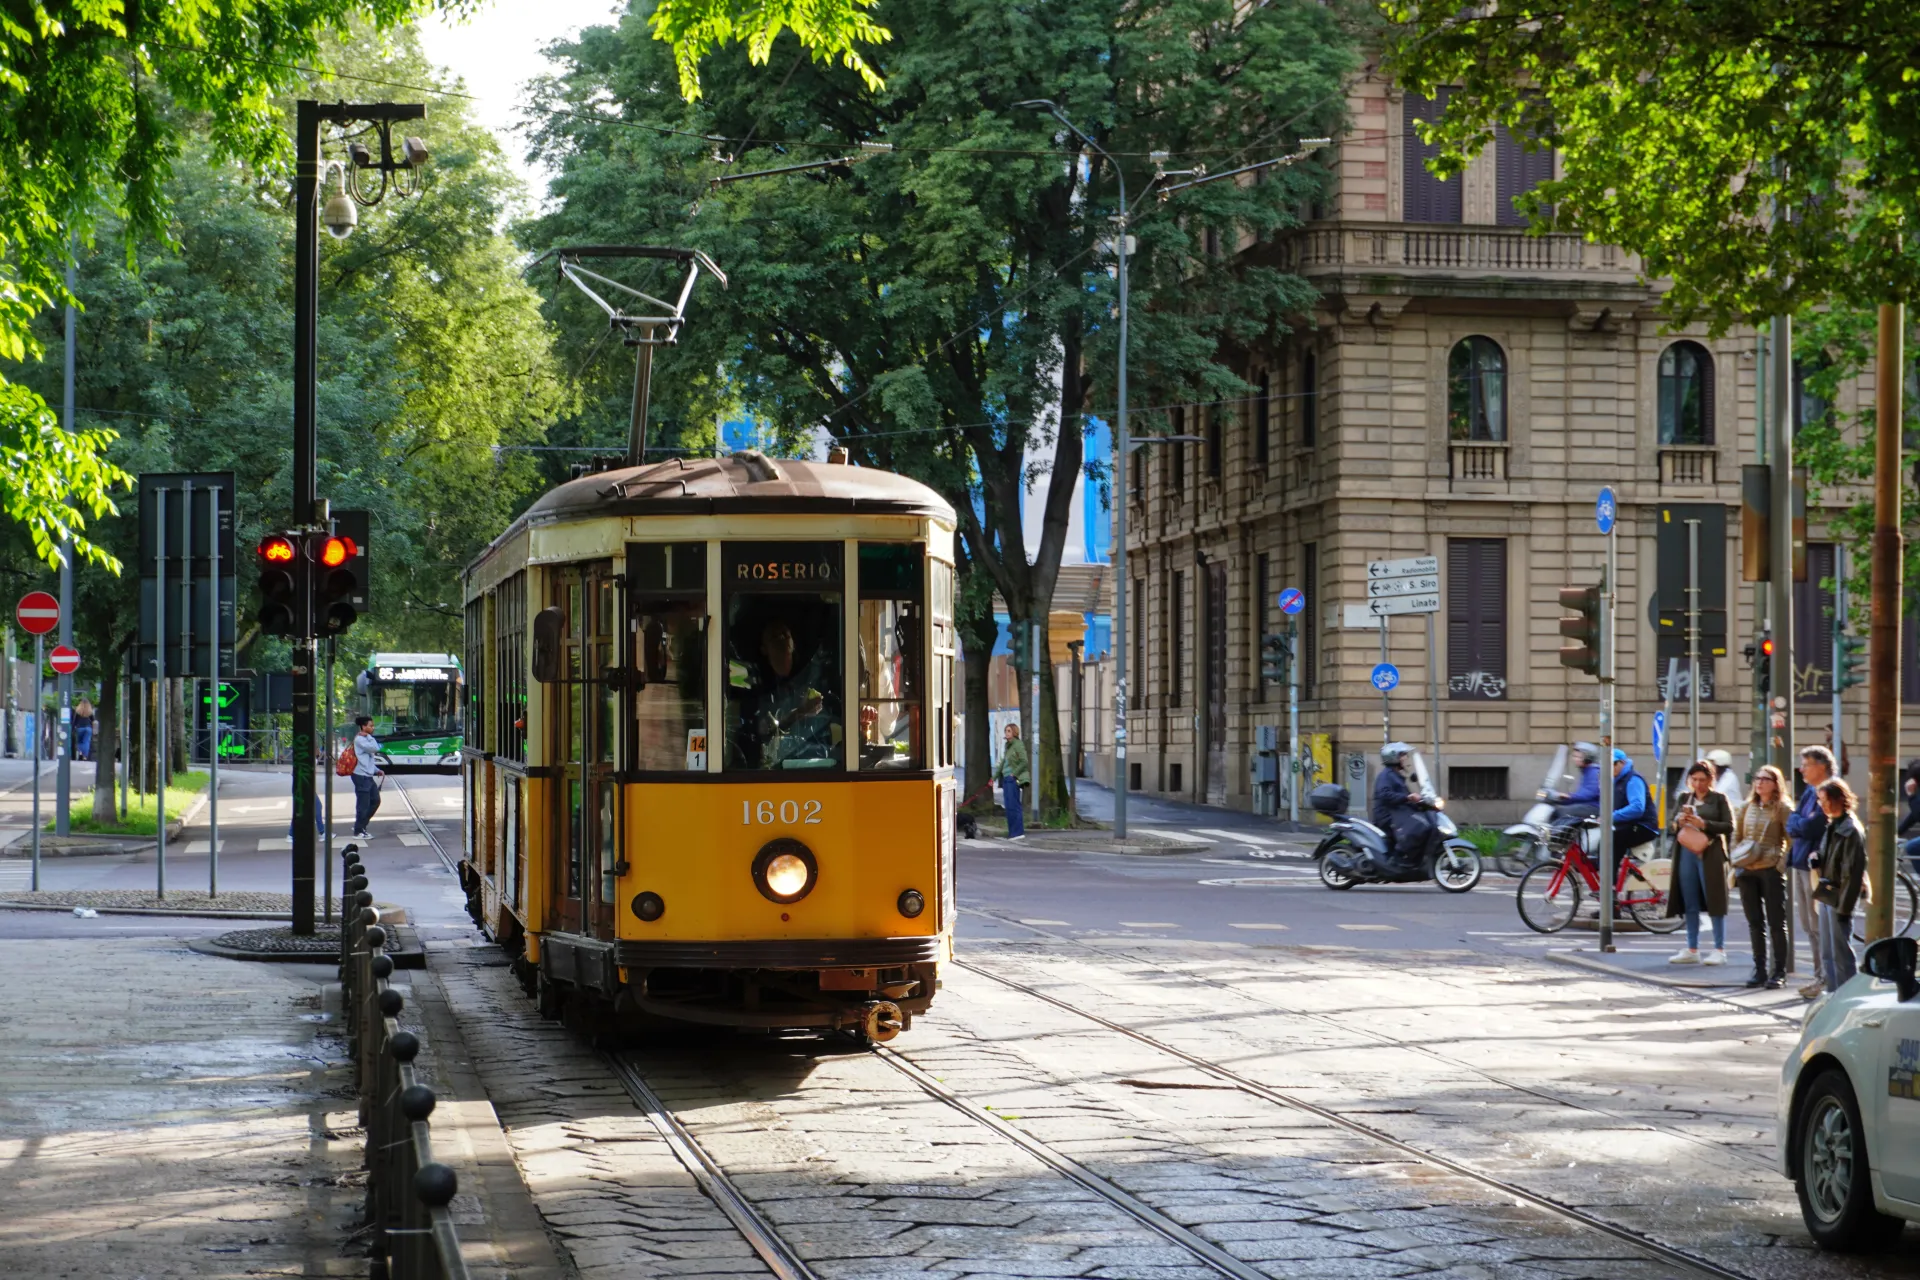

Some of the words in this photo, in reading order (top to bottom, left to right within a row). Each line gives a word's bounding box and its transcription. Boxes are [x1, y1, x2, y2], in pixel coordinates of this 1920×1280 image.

[737, 562, 831, 580] ROSERIO
[1409, 581, 1417, 589] S.
[1420, 580, 1436, 588] Siro
[1411, 598, 1437, 608] Linate
[691, 737, 706, 752] 14
[694, 753, 700, 767] 1
[742, 800, 822, 825] 1602
